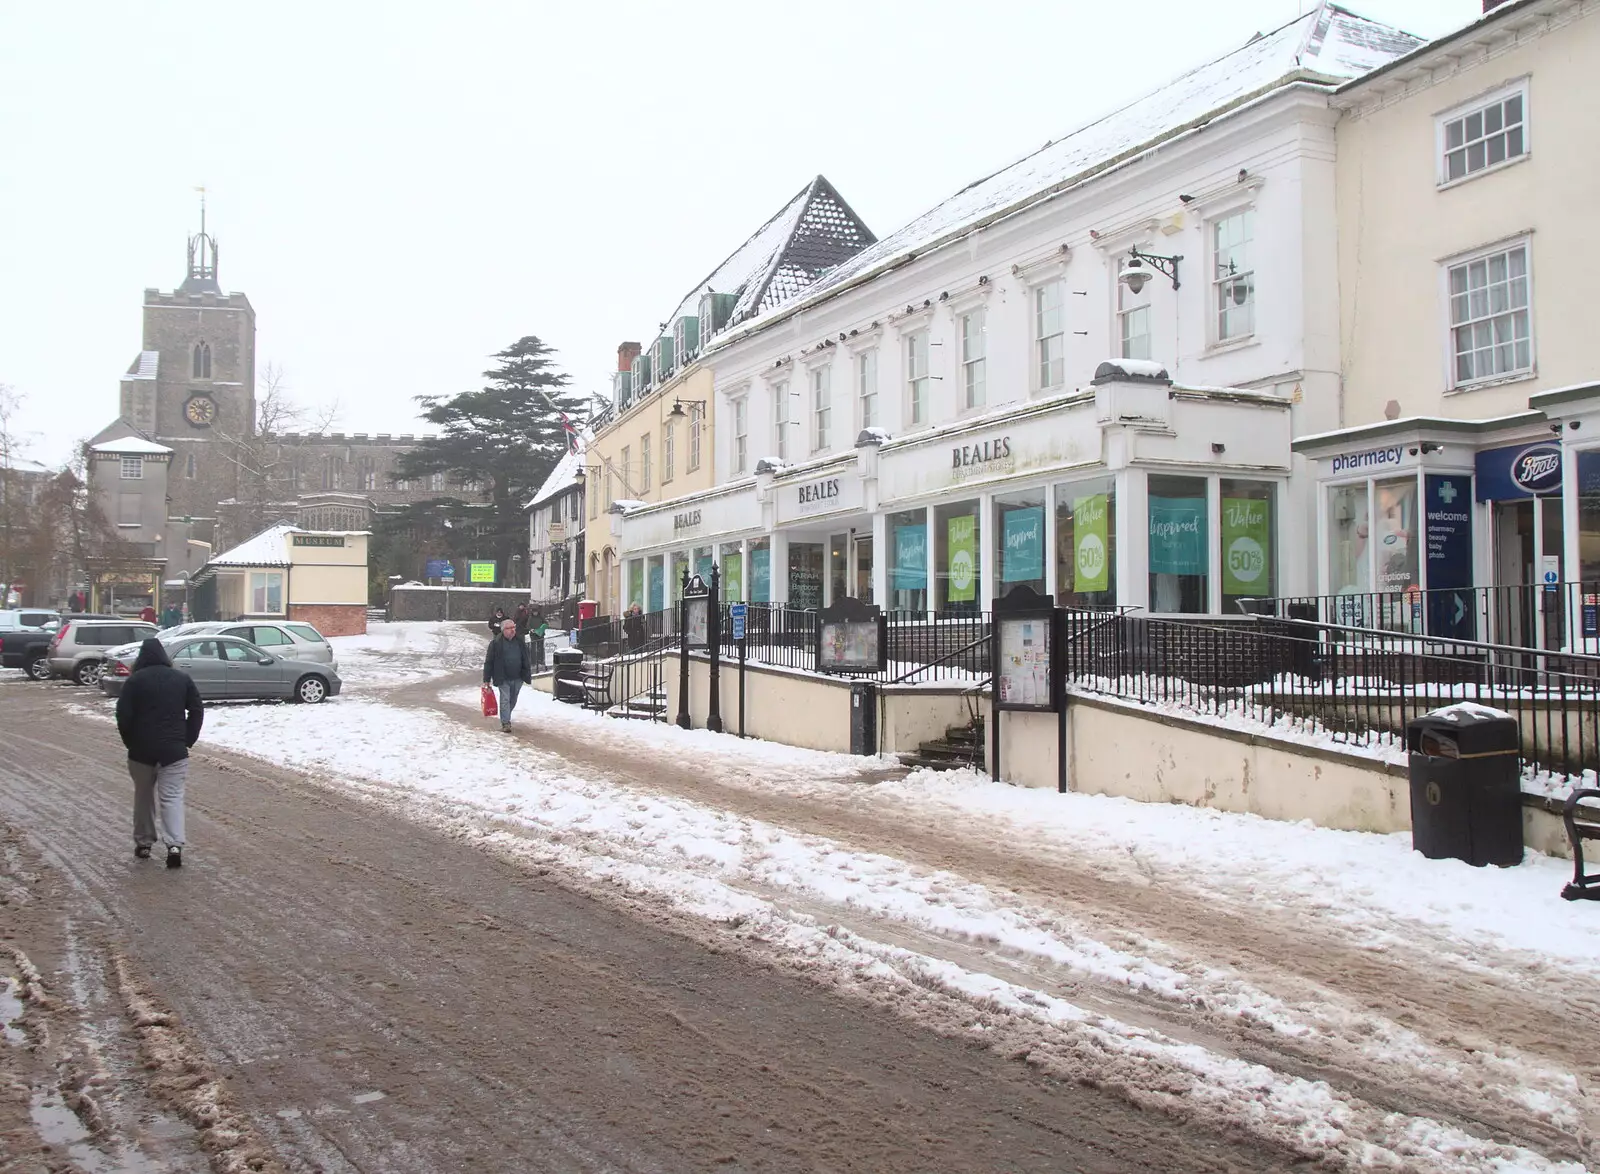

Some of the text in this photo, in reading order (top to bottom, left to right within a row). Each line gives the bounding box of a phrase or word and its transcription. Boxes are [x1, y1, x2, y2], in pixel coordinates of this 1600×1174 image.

[953, 436, 1010, 468] BEALES
[1332, 446, 1403, 474] pharmacy
[1519, 454, 1559, 483] Boots
[798, 478, 839, 504] BEALES
[674, 509, 702, 529] BEALES
[1076, 500, 1104, 526] Value
[1226, 502, 1264, 528] Value
[1428, 510, 1469, 522] welcome
[1150, 515, 1200, 541] Inspired
[1428, 526, 1456, 534] pharmacy
[1428, 534, 1447, 542] beauty
[295, 537, 343, 546] MUSEUM
[1428, 543, 1443, 551] baby
[1231, 550, 1262, 571] 50%
[1429, 552, 1446, 560] photo
[791, 572, 819, 581] FARAH
